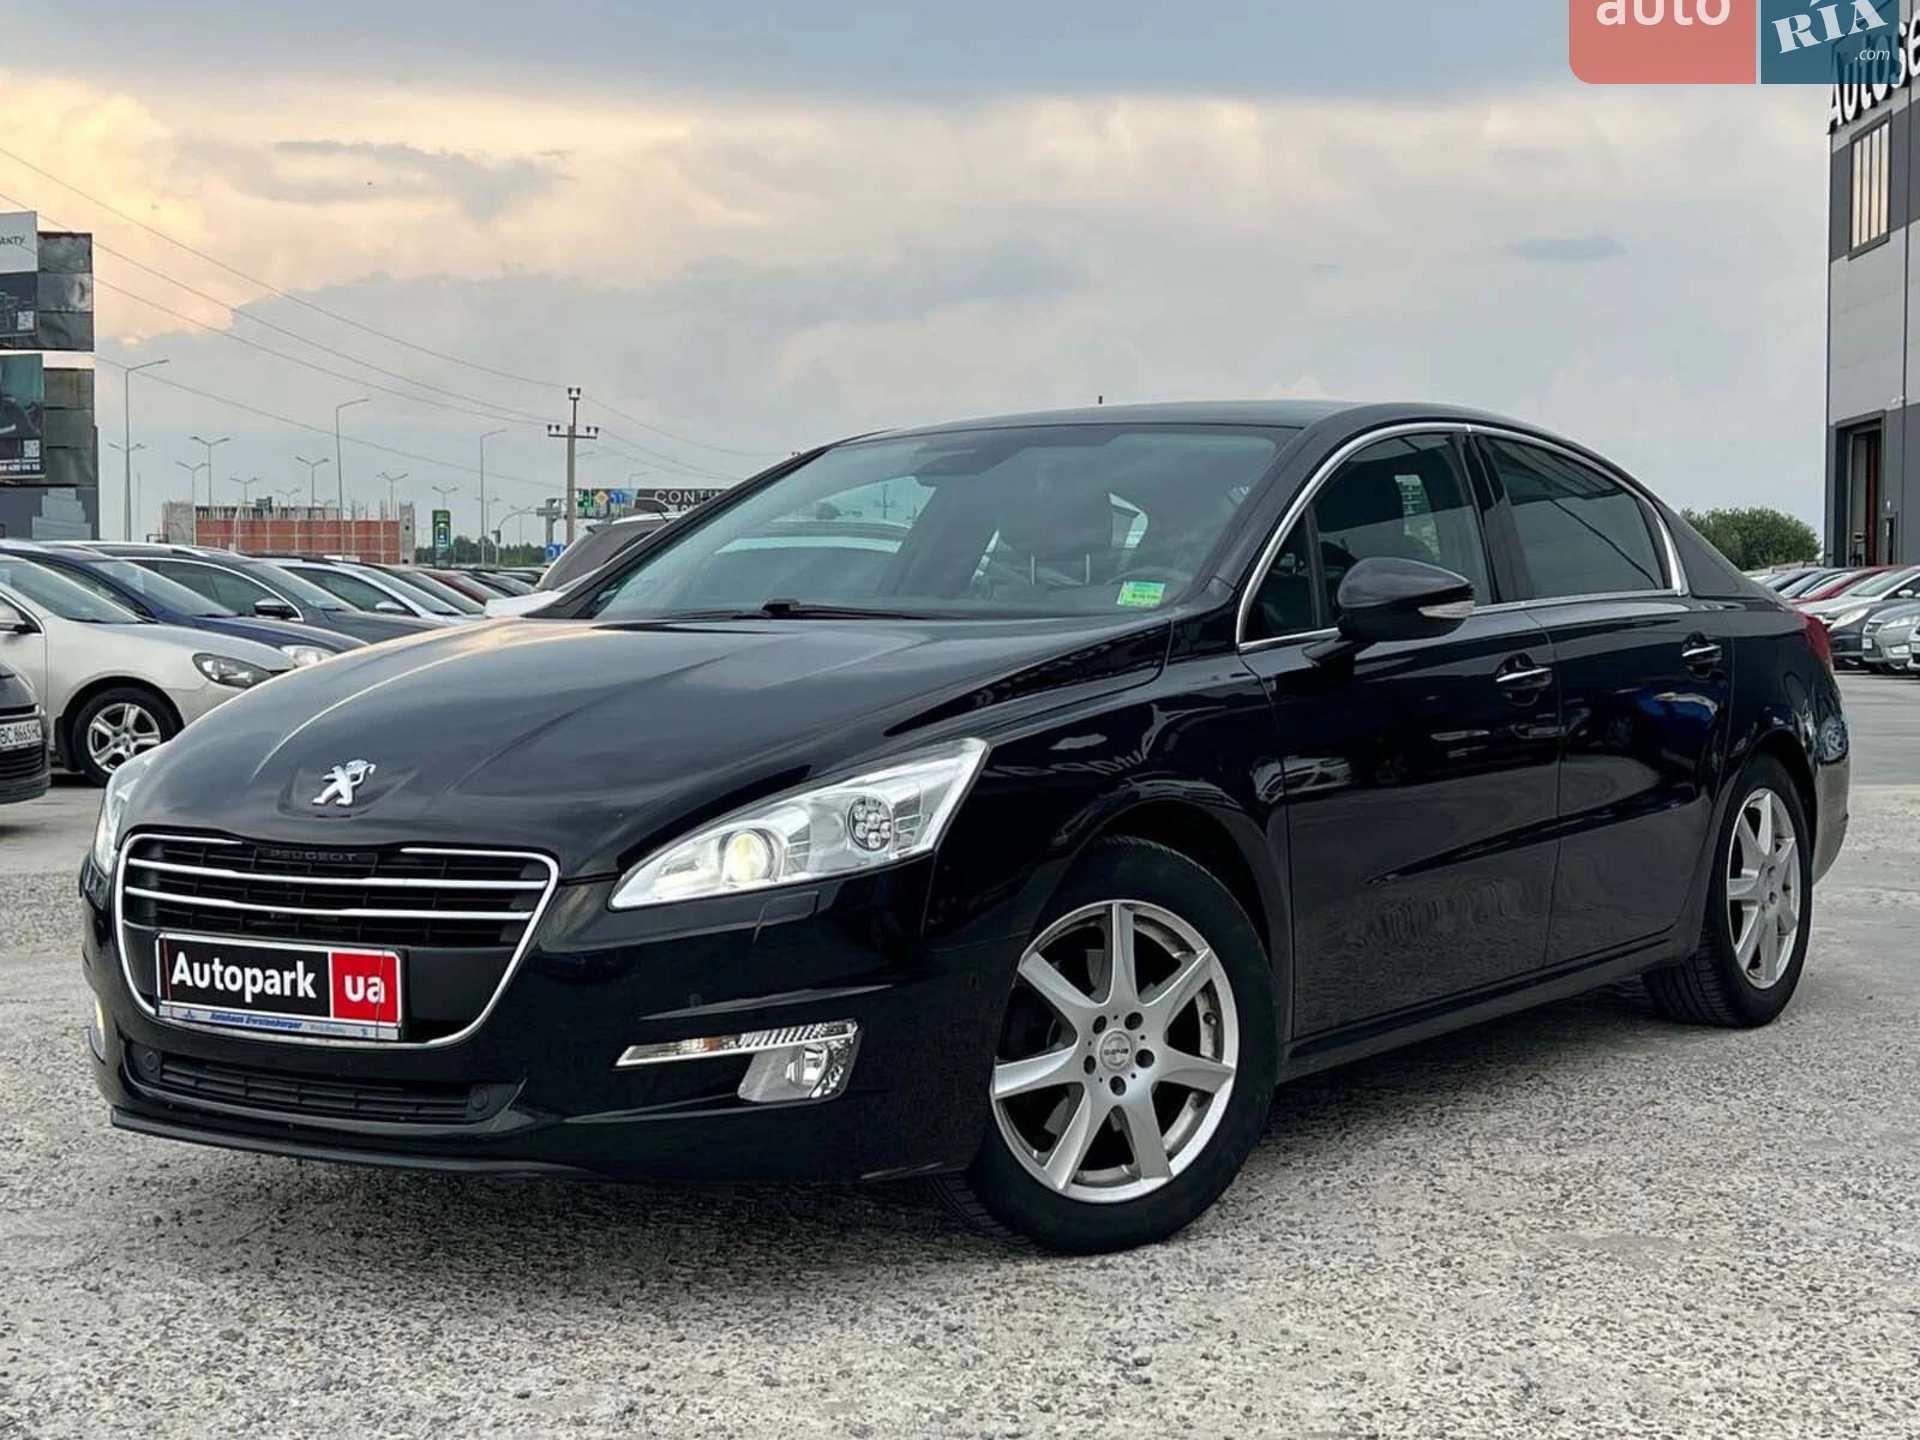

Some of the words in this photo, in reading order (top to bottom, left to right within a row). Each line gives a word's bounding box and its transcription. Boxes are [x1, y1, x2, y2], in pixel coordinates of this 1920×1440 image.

[270, 849, 357, 862] PEUGEOT
[171, 951, 317, 1003] Autopark
[344, 974, 386, 1004] ua
